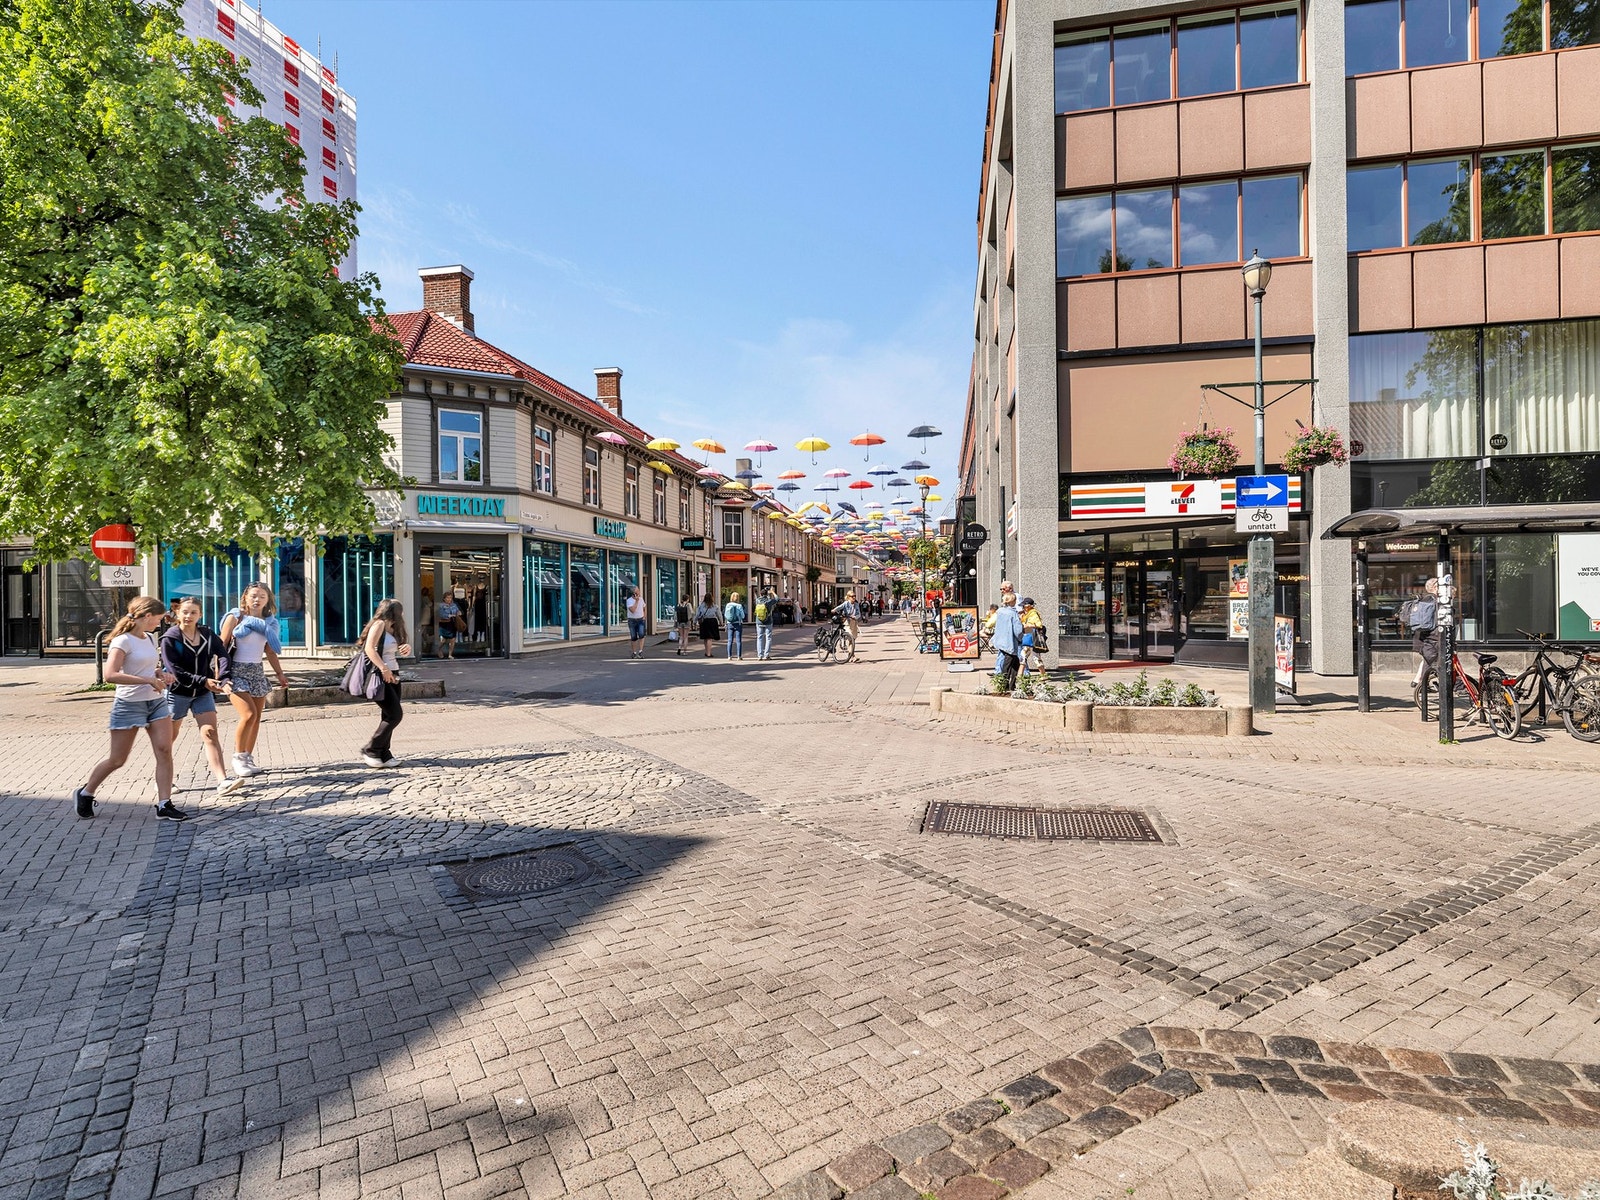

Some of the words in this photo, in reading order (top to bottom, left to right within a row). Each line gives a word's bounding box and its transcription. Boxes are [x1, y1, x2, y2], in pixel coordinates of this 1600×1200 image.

[418, 495, 505, 517] WEEKDAY
[594, 516, 626, 539] WEEKDAY
[954, 638, 967, 647] 1/2
